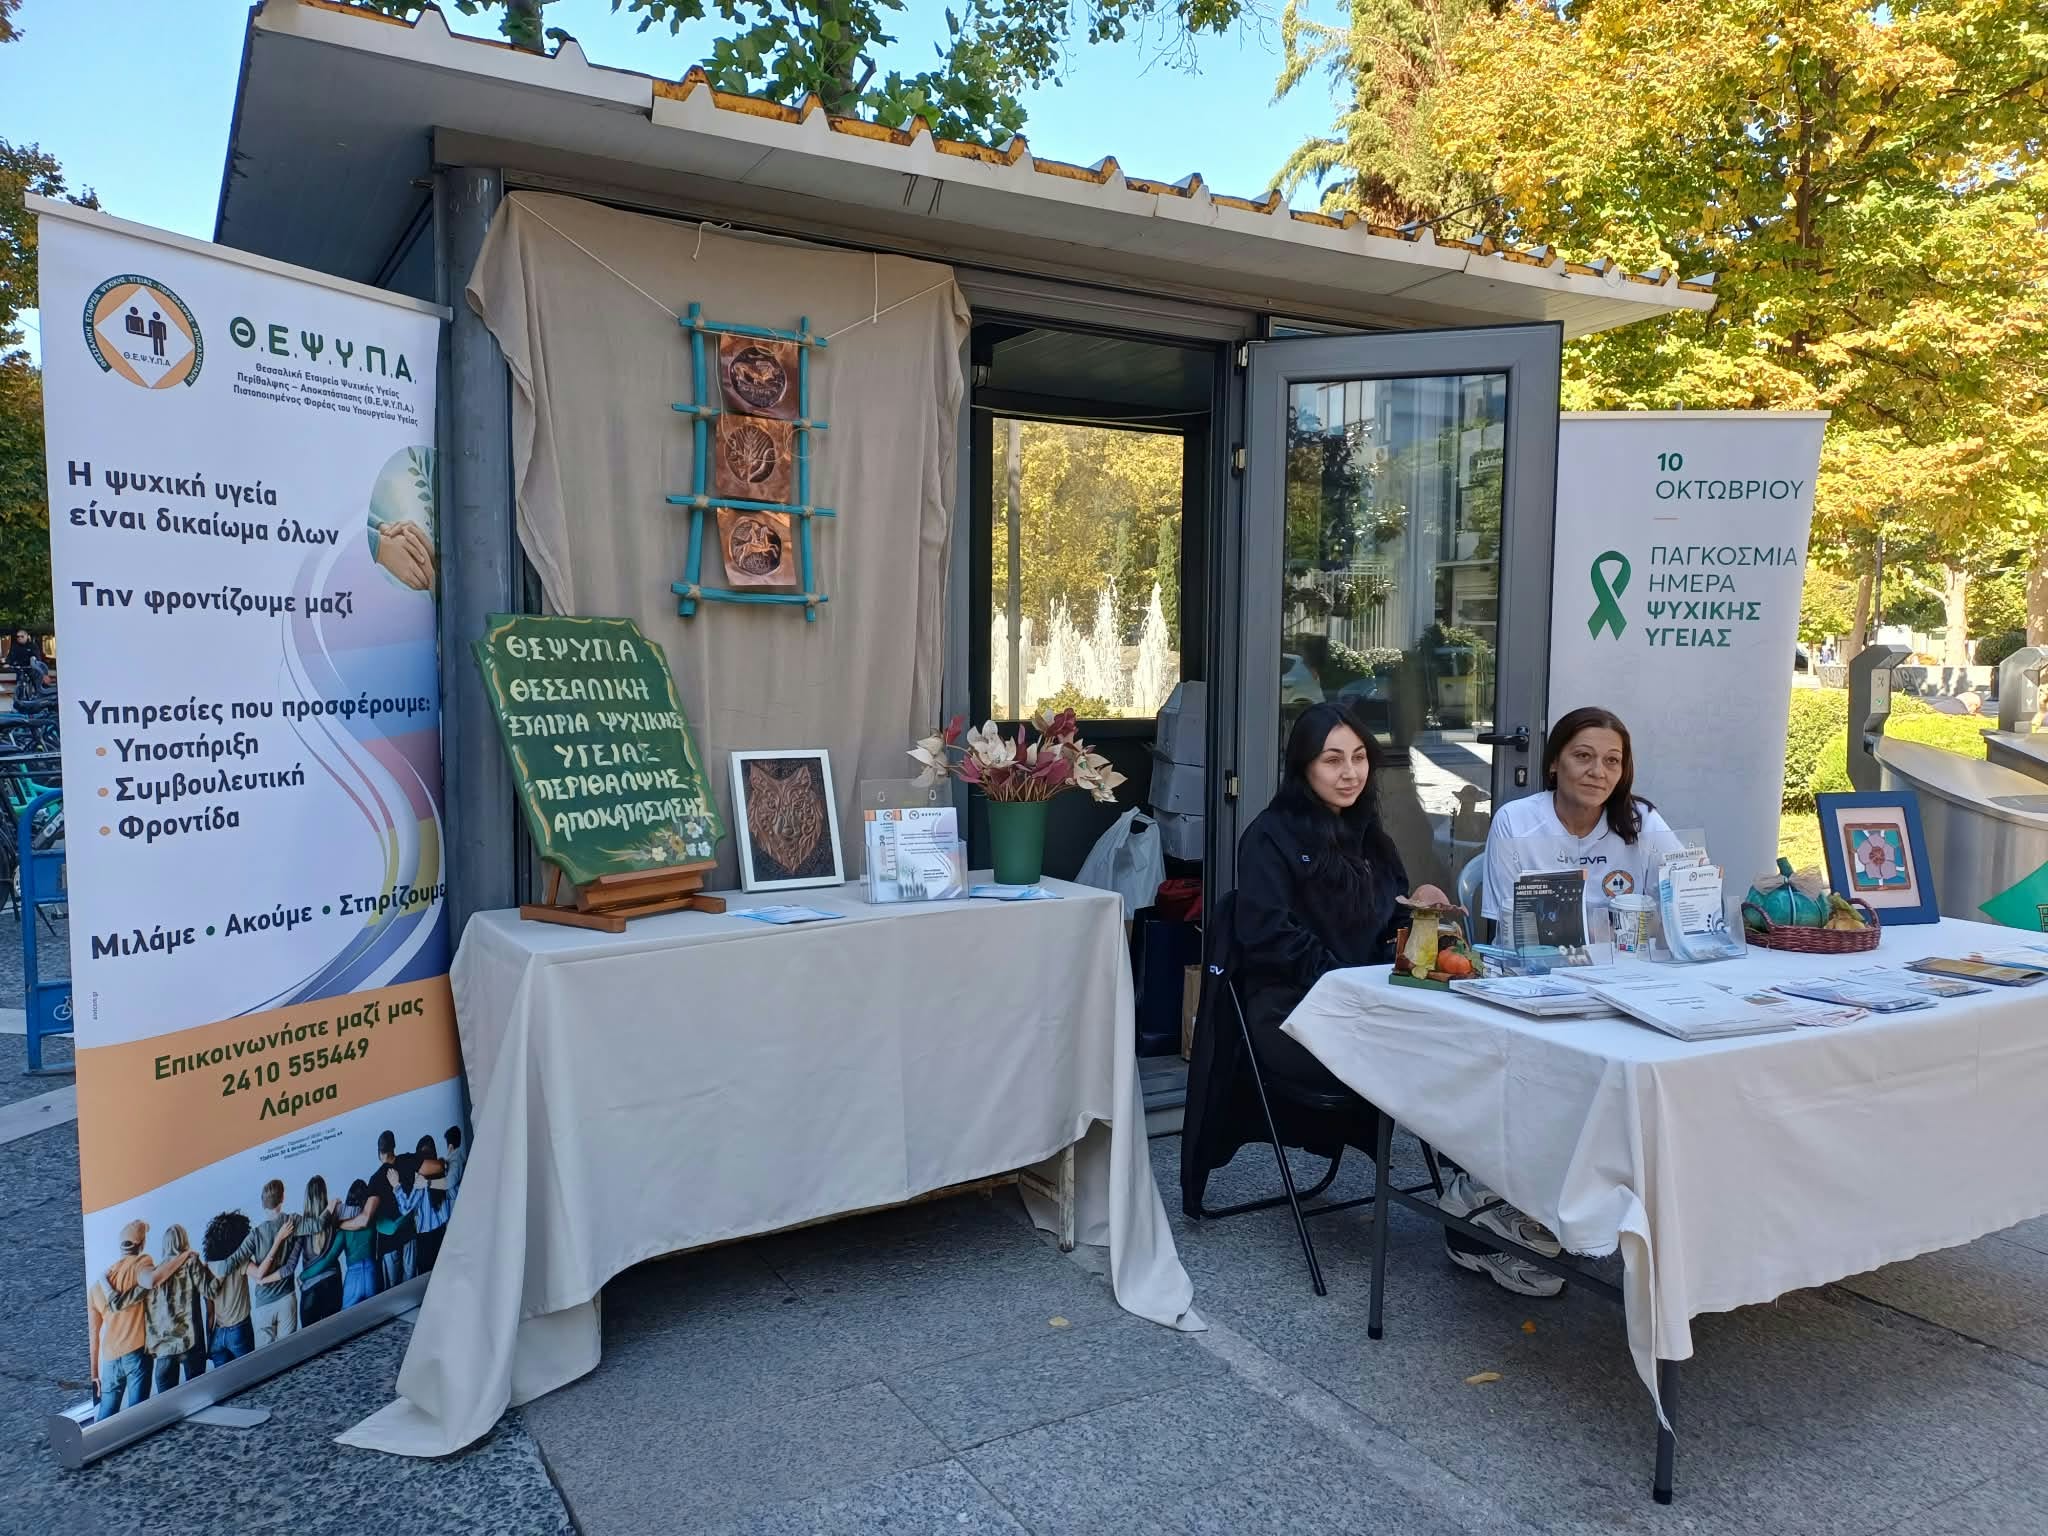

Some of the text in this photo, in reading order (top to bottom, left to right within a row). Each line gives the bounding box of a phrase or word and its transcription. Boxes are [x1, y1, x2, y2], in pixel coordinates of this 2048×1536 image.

[233, 384, 301, 405] Πιστοποιημένος
[303, 396, 336, 412] Φορέας
[337, 403, 351, 413] του
[237, 372, 290, 391] Περίθαλψης
[300, 383, 362, 405] Αποκατάστασης
[255, 363, 400, 400] Θεσσαλική Εταιρεία Ψυχικής Υγείας
[1657, 452, 1683, 472] 10
[68, 460, 277, 507] Η ψυχική υγεία
[1655, 480, 1804, 500] ΟΚΤΩΒΡΙΟΥ
[69, 500, 339, 545] είναι δικαίωμα όλων
[1650, 546, 1798, 566] ΠΑΓΚΟΣΜΙΑ
[71, 581, 353, 619] Την φροντίζουμε μαζί
[1649, 574, 1736, 593] ΗΜΕΡΑ
[1647, 601, 1762, 621] ΨΥΧΙΚΗΣ
[1645, 628, 1732, 647] ΥΓΕΙΑΣ
[509, 677, 650, 702] ΘΕΣΣΑΛΙΚΗ
[79, 692, 431, 729] Υπηρεσίες που προσφέρουμε:
[508, 711, 683, 737] ΕΤΑΙΡΙΑ ΨΥΧΙΚΗΣ
[113, 731, 259, 763] Υποστήριξη
[115, 762, 305, 805] Συμβουλευτική
[118, 806, 240, 844] Φροντίδα
[554, 798, 714, 841] ΑΠΟΚΑΤΑΣΤΑΣΗΣ
[91, 883, 446, 959] Μιλάμε Ακούμε Στηρίζουμε
[154, 996, 425, 1081] Επικοινωνήστε μαζί μας
[221, 1036, 370, 1097] 2410 555449
[259, 1081, 339, 1121] Λάρισα
